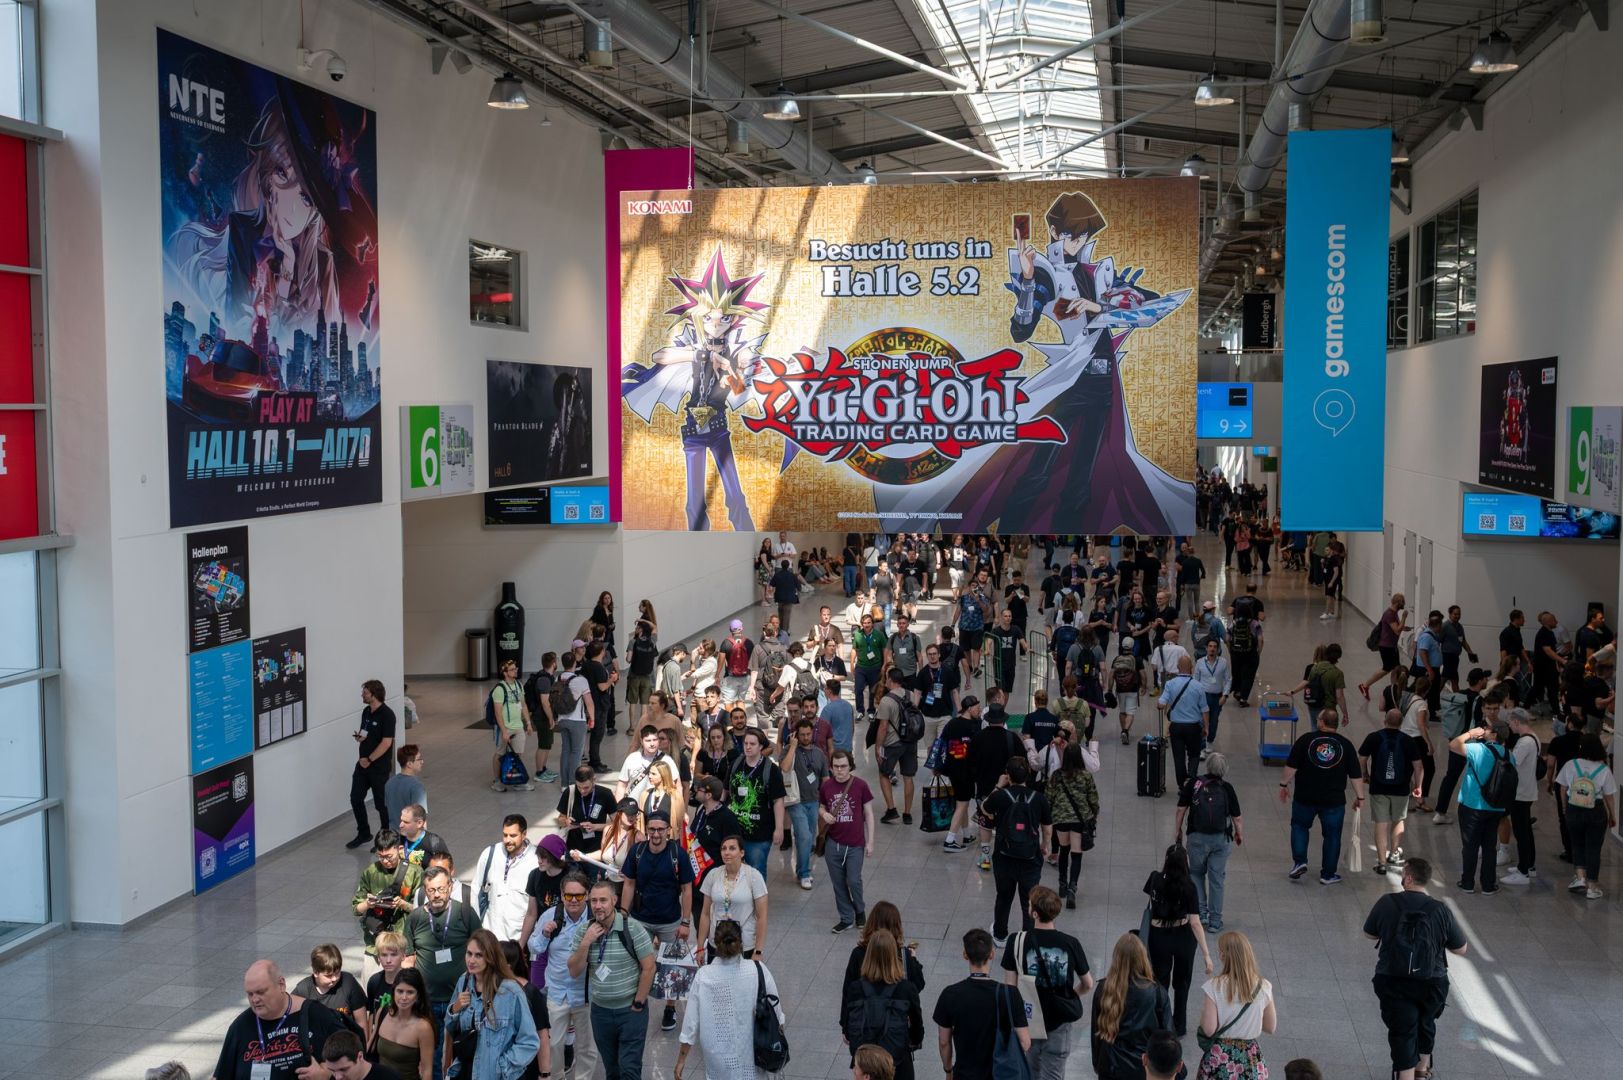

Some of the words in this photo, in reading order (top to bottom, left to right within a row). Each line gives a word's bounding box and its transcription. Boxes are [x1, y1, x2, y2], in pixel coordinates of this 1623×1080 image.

[169, 72, 226, 125] NTE
[627, 199, 693, 215] KONAMI
[808, 237, 908, 261] Besucht
[912, 241, 960, 260] uns
[965, 237, 992, 259] in
[821, 264, 921, 297] Halle
[930, 265, 980, 296] 5.2
[1325, 224, 1350, 378] gamescom
[1260, 299, 1272, 344] Lindbergh
[852, 358, 909, 371] SHONEN
[911, 357, 951, 371] JUMP
[259, 396, 293, 424] PLAY
[295, 396, 314, 424] AT
[784, 376, 1027, 424] Yu-Gi-Oh!
[792, 423, 885, 441] TRADING
[889, 423, 950, 441] CARD
[953, 422, 1017, 440] GAME
[1219, 418, 1230, 433] 9
[186, 429, 250, 480] HALL
[420, 427, 438, 487] 6
[1576, 430, 1590, 495] 9
[237, 481, 276, 493] WELCOME
[281, 480, 290, 489] TO
[192, 545, 229, 559] Hallenplan
